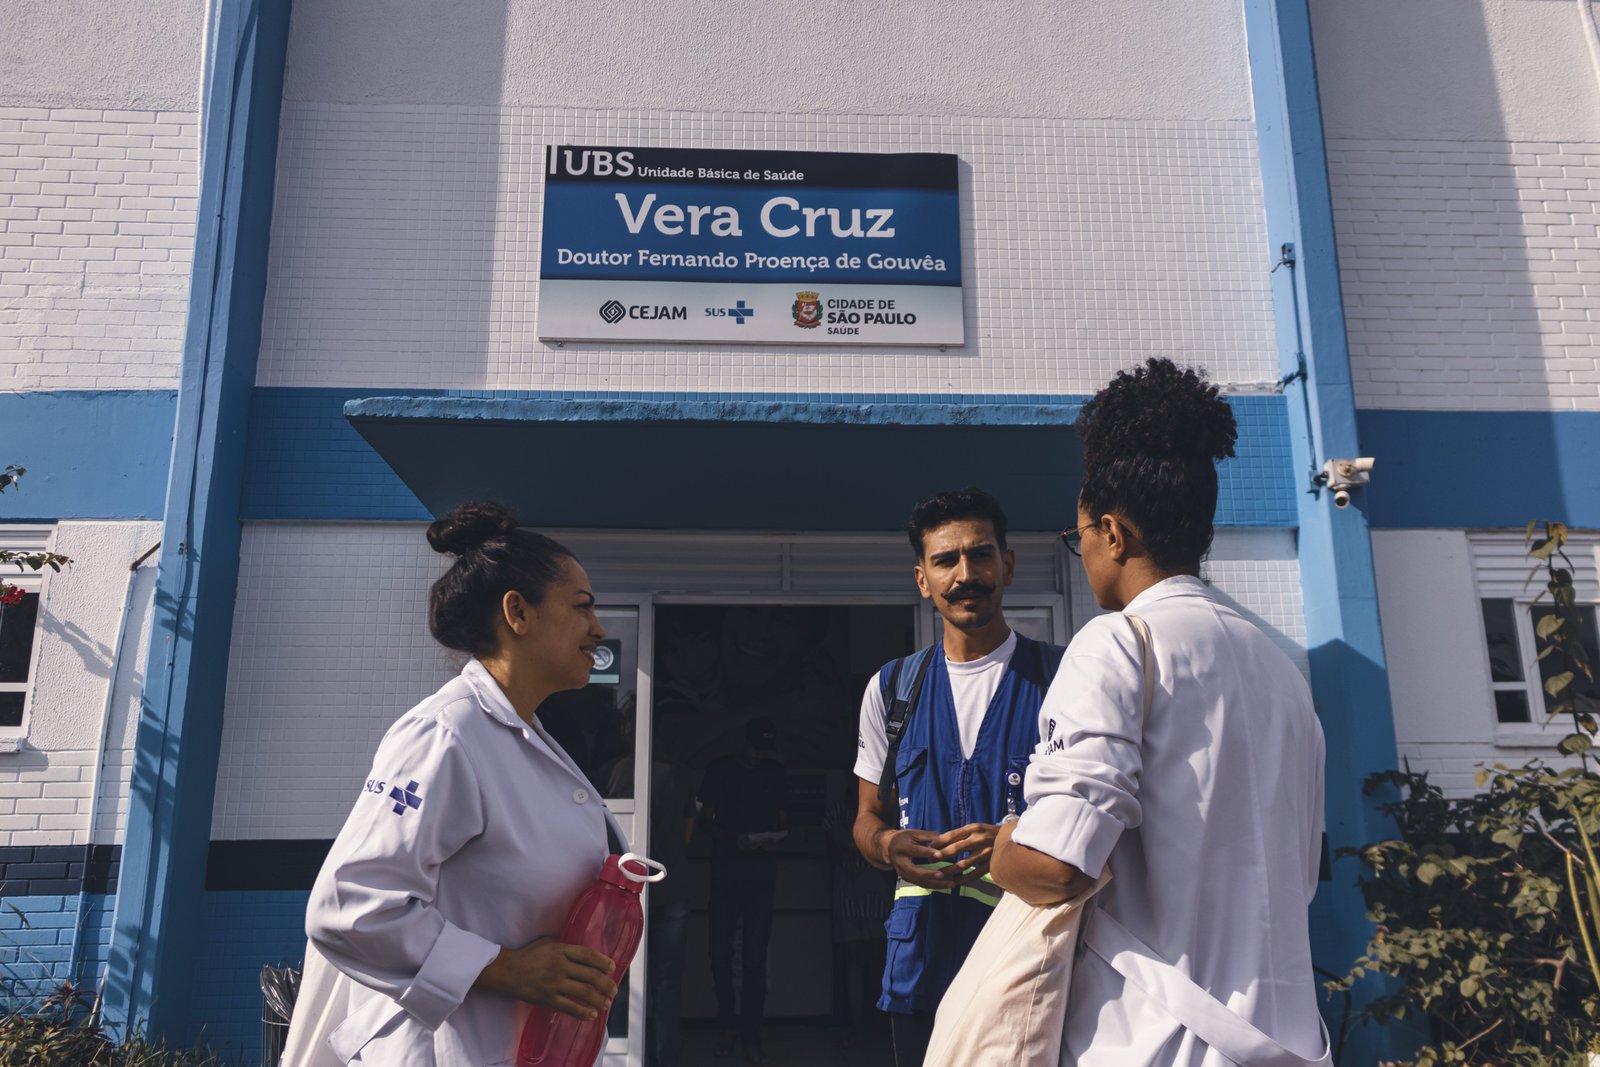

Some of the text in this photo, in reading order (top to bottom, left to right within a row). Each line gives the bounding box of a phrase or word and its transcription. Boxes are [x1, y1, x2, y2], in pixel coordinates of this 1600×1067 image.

[564, 150, 804, 181] UBS Unidade Básica de Saúde
[615, 192, 895, 238] Vera Cruz
[557, 248, 946, 273] Doutor Fernando Proença de Gouvêa
[705, 307, 726, 317] SUS
[827, 299, 895, 310] CIDADE DE
[629, 305, 687, 320] CEJAM
[827, 309, 917, 325] SÃO PAULO
[827, 325, 859, 335] SAÚDE
